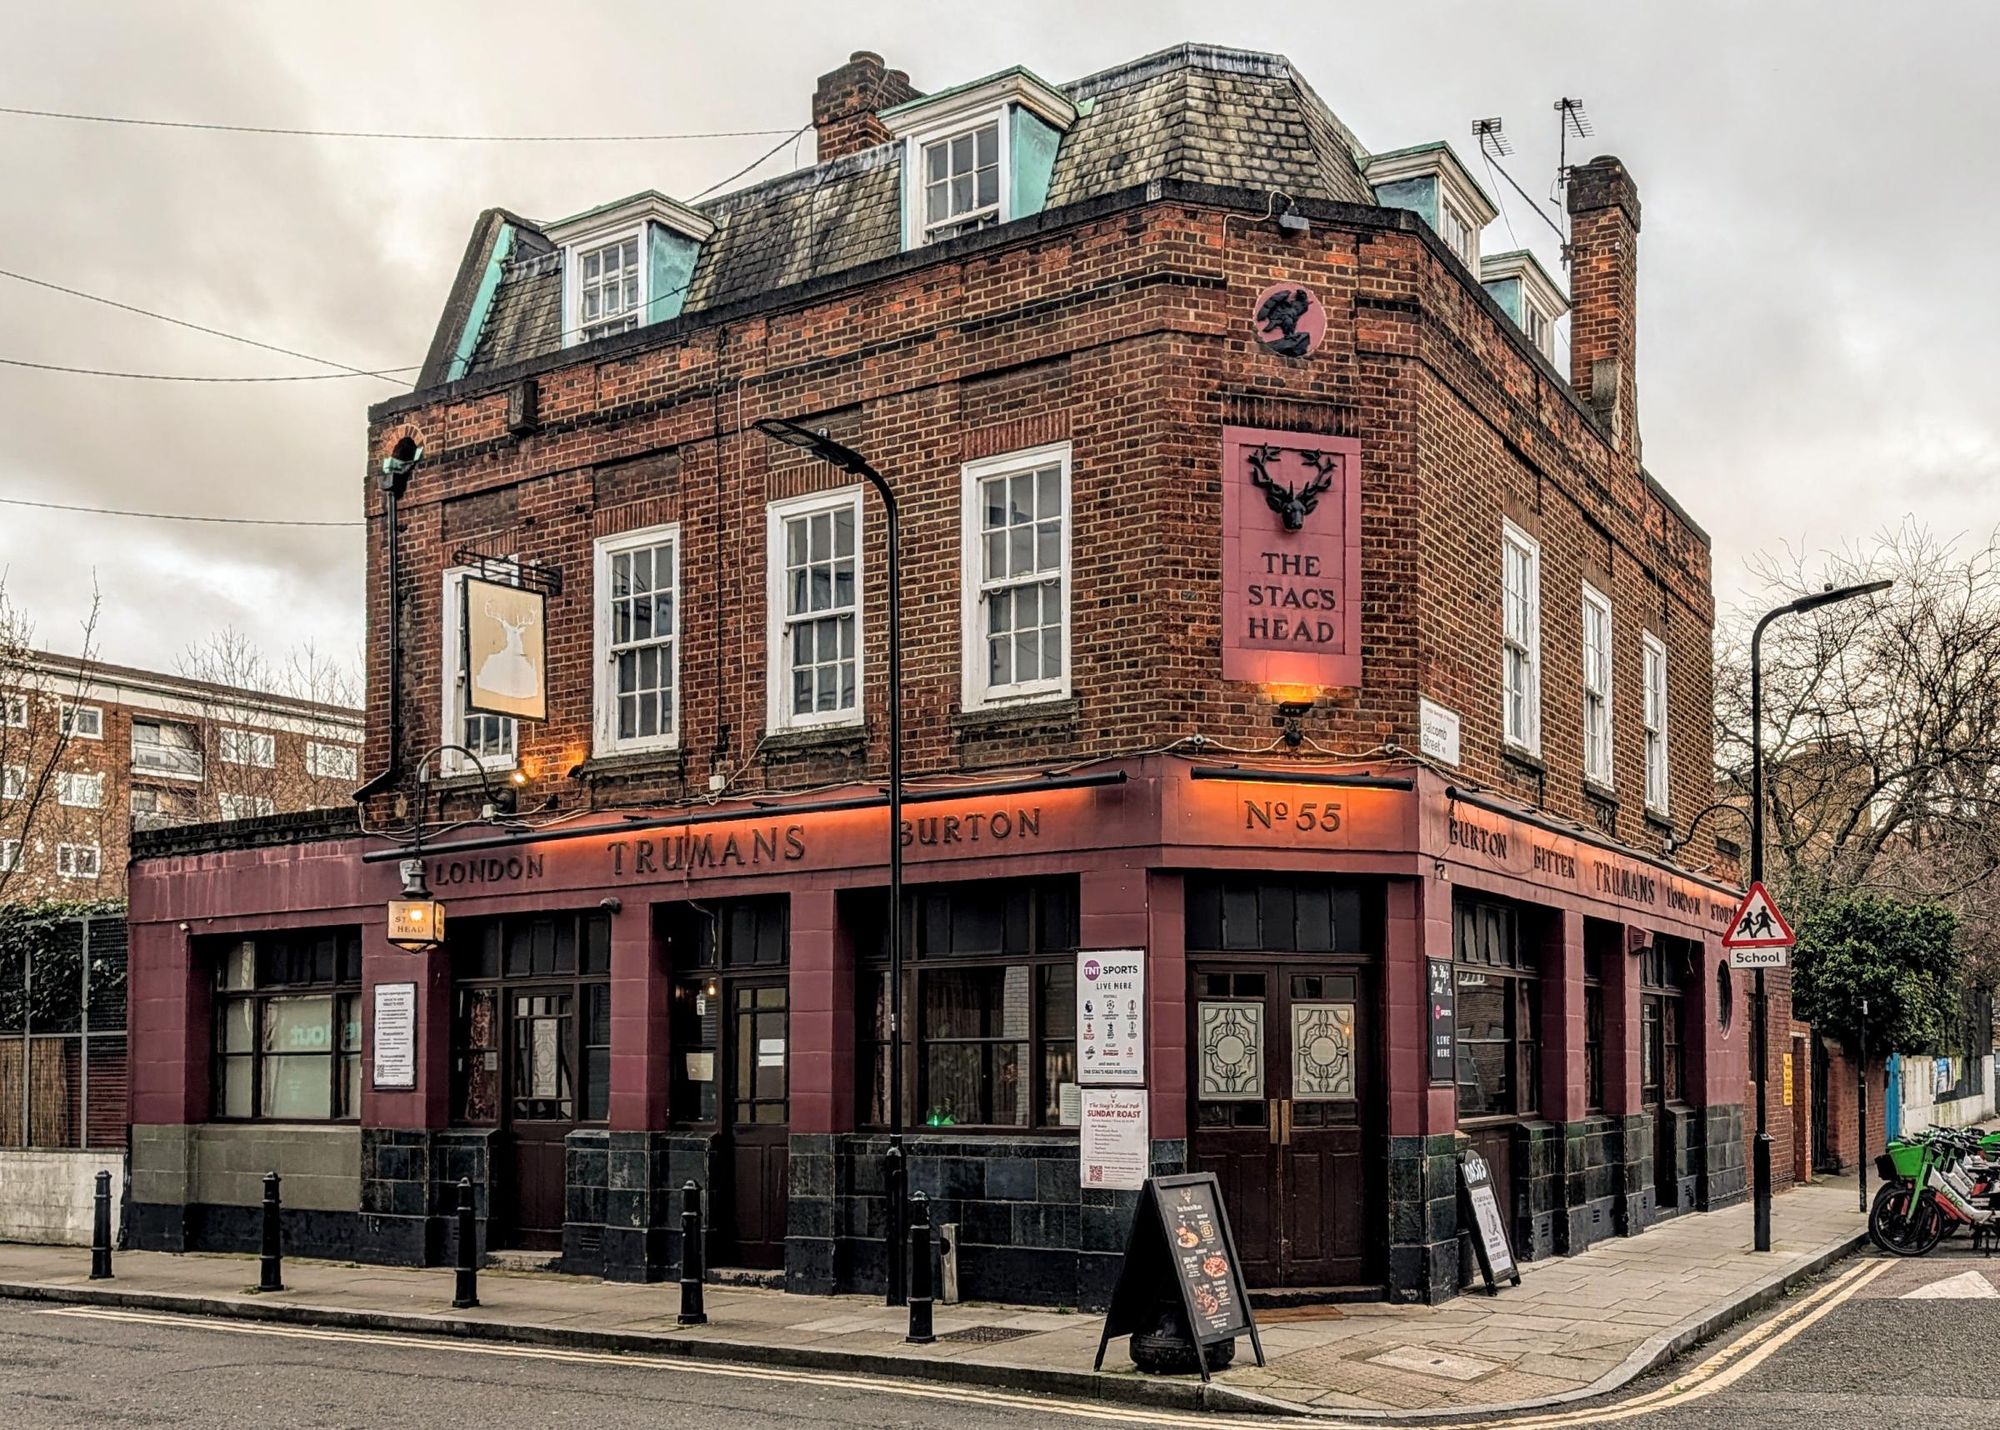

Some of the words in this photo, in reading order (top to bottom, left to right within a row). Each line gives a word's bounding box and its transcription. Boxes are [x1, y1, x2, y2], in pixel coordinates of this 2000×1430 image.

[1261, 552, 1321, 577] THE
[1248, 618, 1335, 643] HEAD
[1296, 803, 1341, 832] 55
[435, 853, 544, 886] LONDON
[607, 825, 806, 875] TRUMANS
[900, 806, 1041, 846] BURTON
[1449, 817, 1507, 860] BURTON
[1533, 844, 1576, 879] BITTER
[1593, 859, 1655, 906] TRUMANS
[1667, 886, 1701, 916] LONDON
[1084, 966, 1100, 975] TNT
[1102, 965, 1138, 975] SPORTS
[1736, 952, 1781, 964] School
[1096, 982, 1111, 990] LIVE
[1113, 982, 1132, 990] HERE
[1087, 1110, 1115, 1118] SUNDAY
[1117, 1110, 1142, 1118] ROAST
